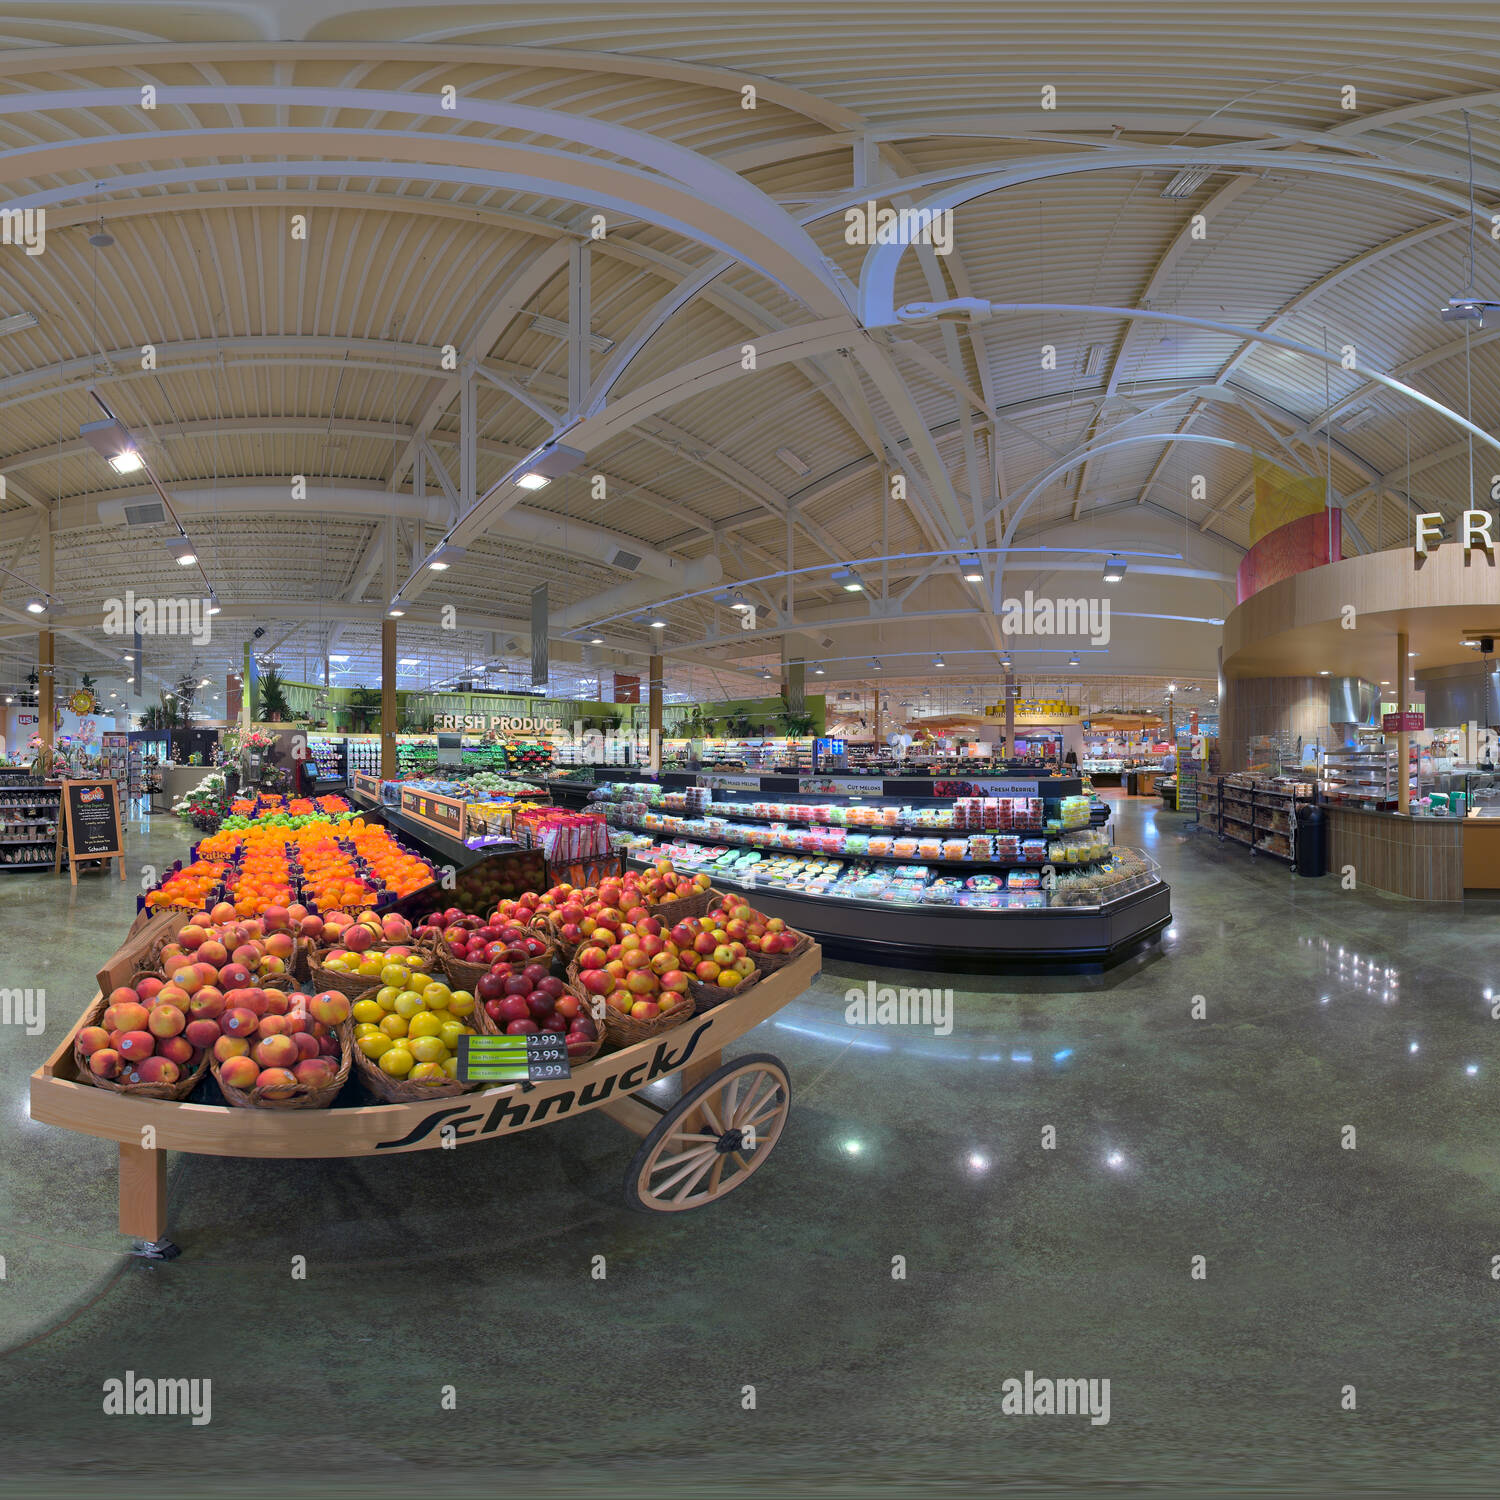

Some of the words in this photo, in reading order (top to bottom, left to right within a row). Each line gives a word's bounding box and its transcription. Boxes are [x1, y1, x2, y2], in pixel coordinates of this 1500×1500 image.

[433, 715, 486, 729] FRESH
[490, 717, 562, 730] PRODUCE
[199, 851, 231, 860] Cuties
[527, 1034, 557, 1046] $2.99
[527, 1049, 559, 1061] $2.99
[530, 1064, 562, 1077] $2.99
[375, 1019, 714, 1149] Schnucks
